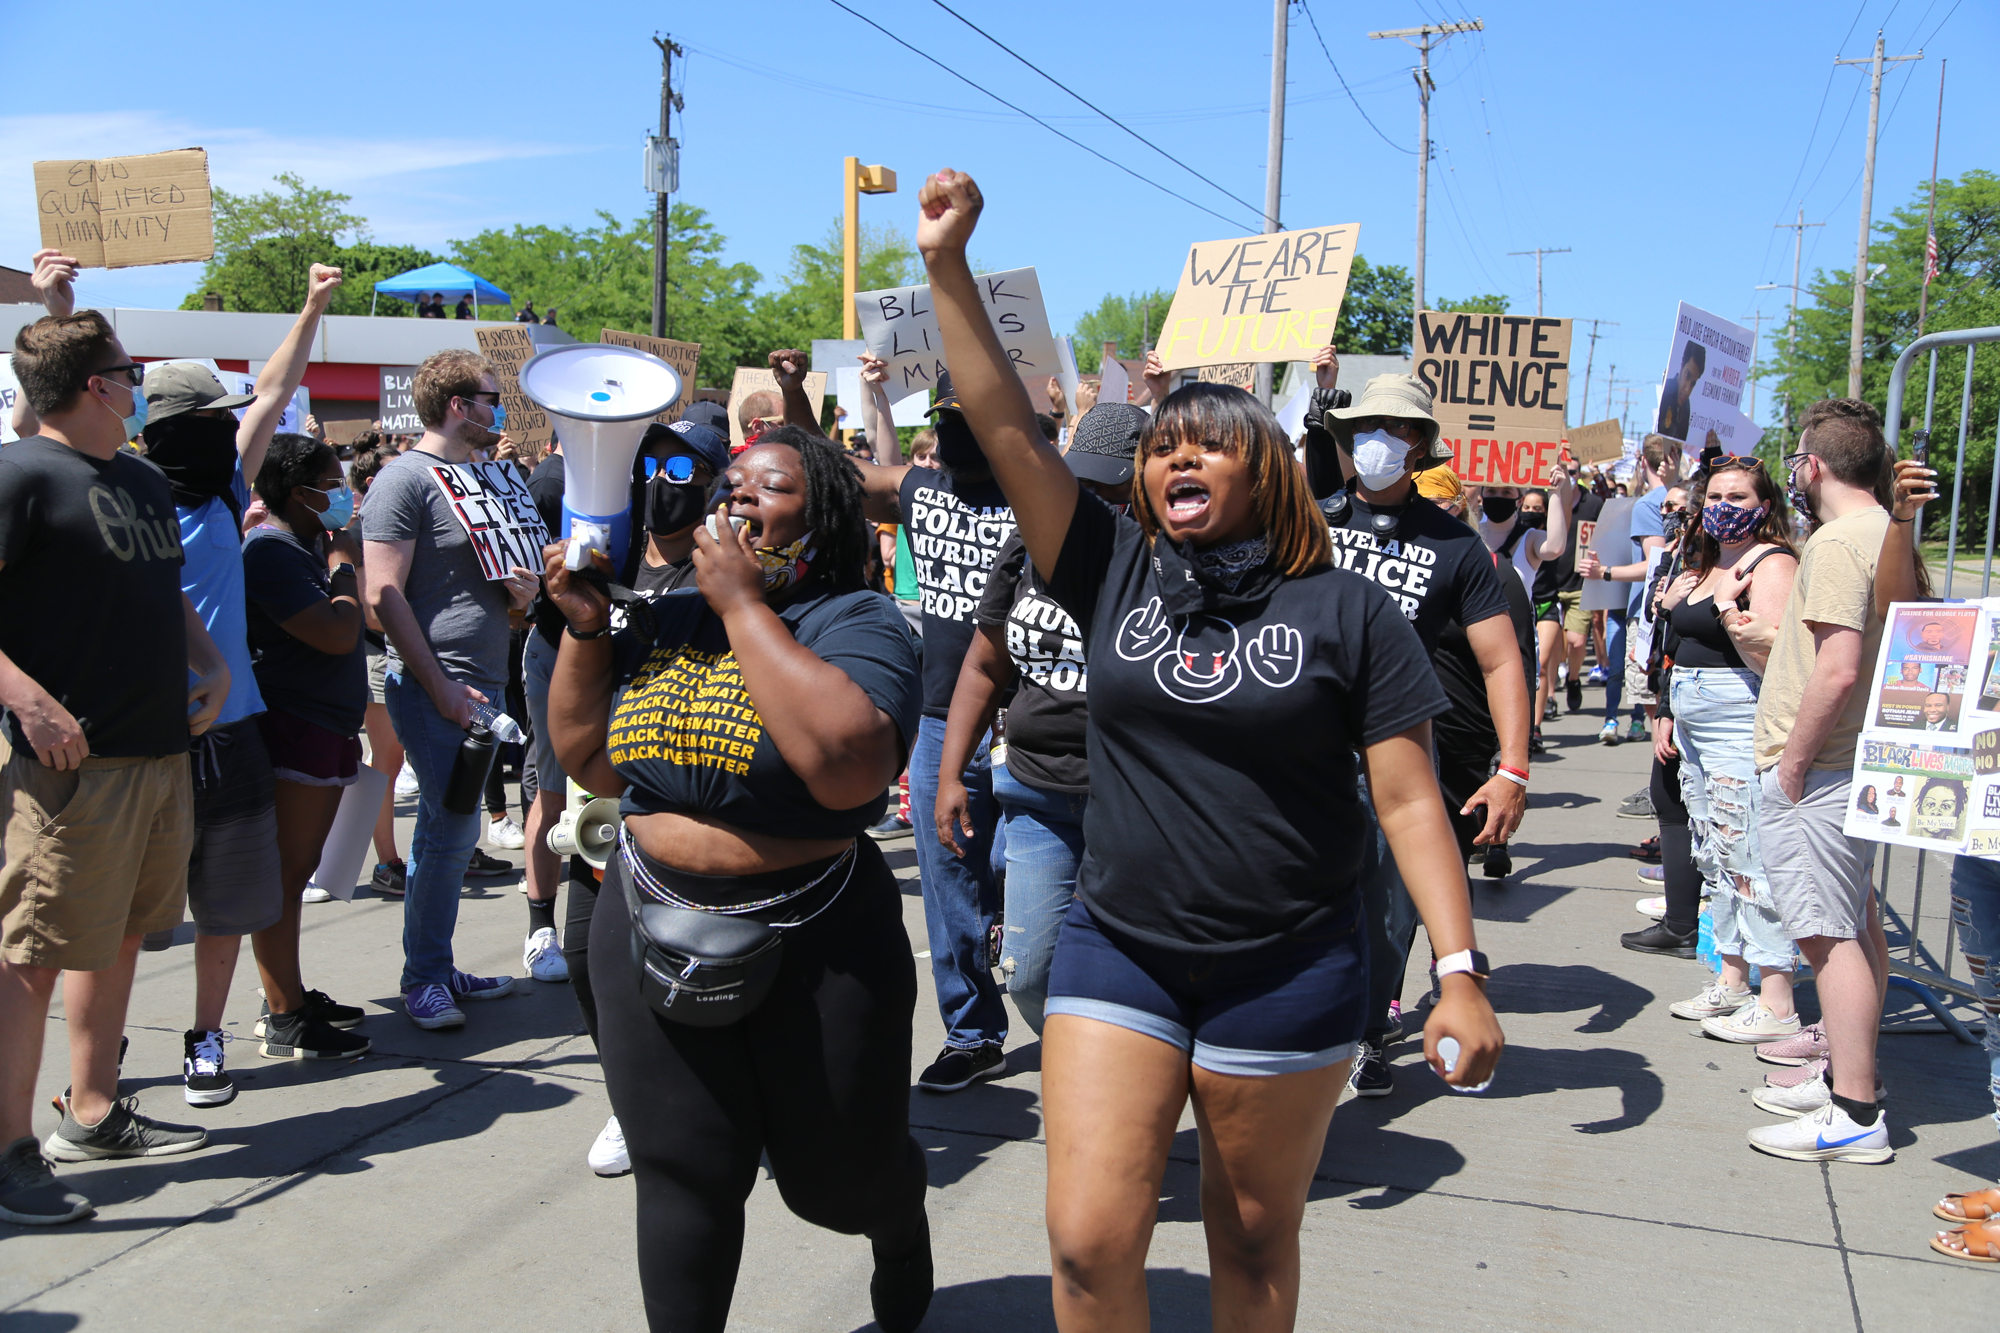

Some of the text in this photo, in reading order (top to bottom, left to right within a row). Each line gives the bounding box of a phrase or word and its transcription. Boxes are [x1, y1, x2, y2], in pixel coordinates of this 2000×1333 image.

[67, 161, 129, 187] END
[39, 183, 185, 218] QUALIFIED
[55, 213, 171, 247] IMMUNITY
[879, 278, 1031, 322] BLK
[1219, 276, 1302, 316] THE
[477, 327, 532, 348] A SYSTEM
[893, 312, 1026, 357] LIS
[1163, 307, 1338, 361] FUTURE
[1418, 312, 1562, 359] WHITE
[384, 374, 413, 391] BLA
[903, 348, 1037, 389] MAR
[1417, 358, 1568, 411] SILENCE
[387, 394, 415, 409] LIV
[433, 461, 527, 501] BLACK
[1441, 438, 1557, 487] LENCE
[454, 493, 542, 532] LIVES
[911, 531, 1000, 571] MURDE
[914, 556, 991, 598] BLAC
[918, 585, 981, 625] PEOP
[1007, 620, 1087, 664] BLA
[1863, 744, 1913, 768] BLACK
[1975, 730, 1997, 750] NO
[1975, 754, 1994, 770] NO
[1971, 838, 1984, 850] Be
